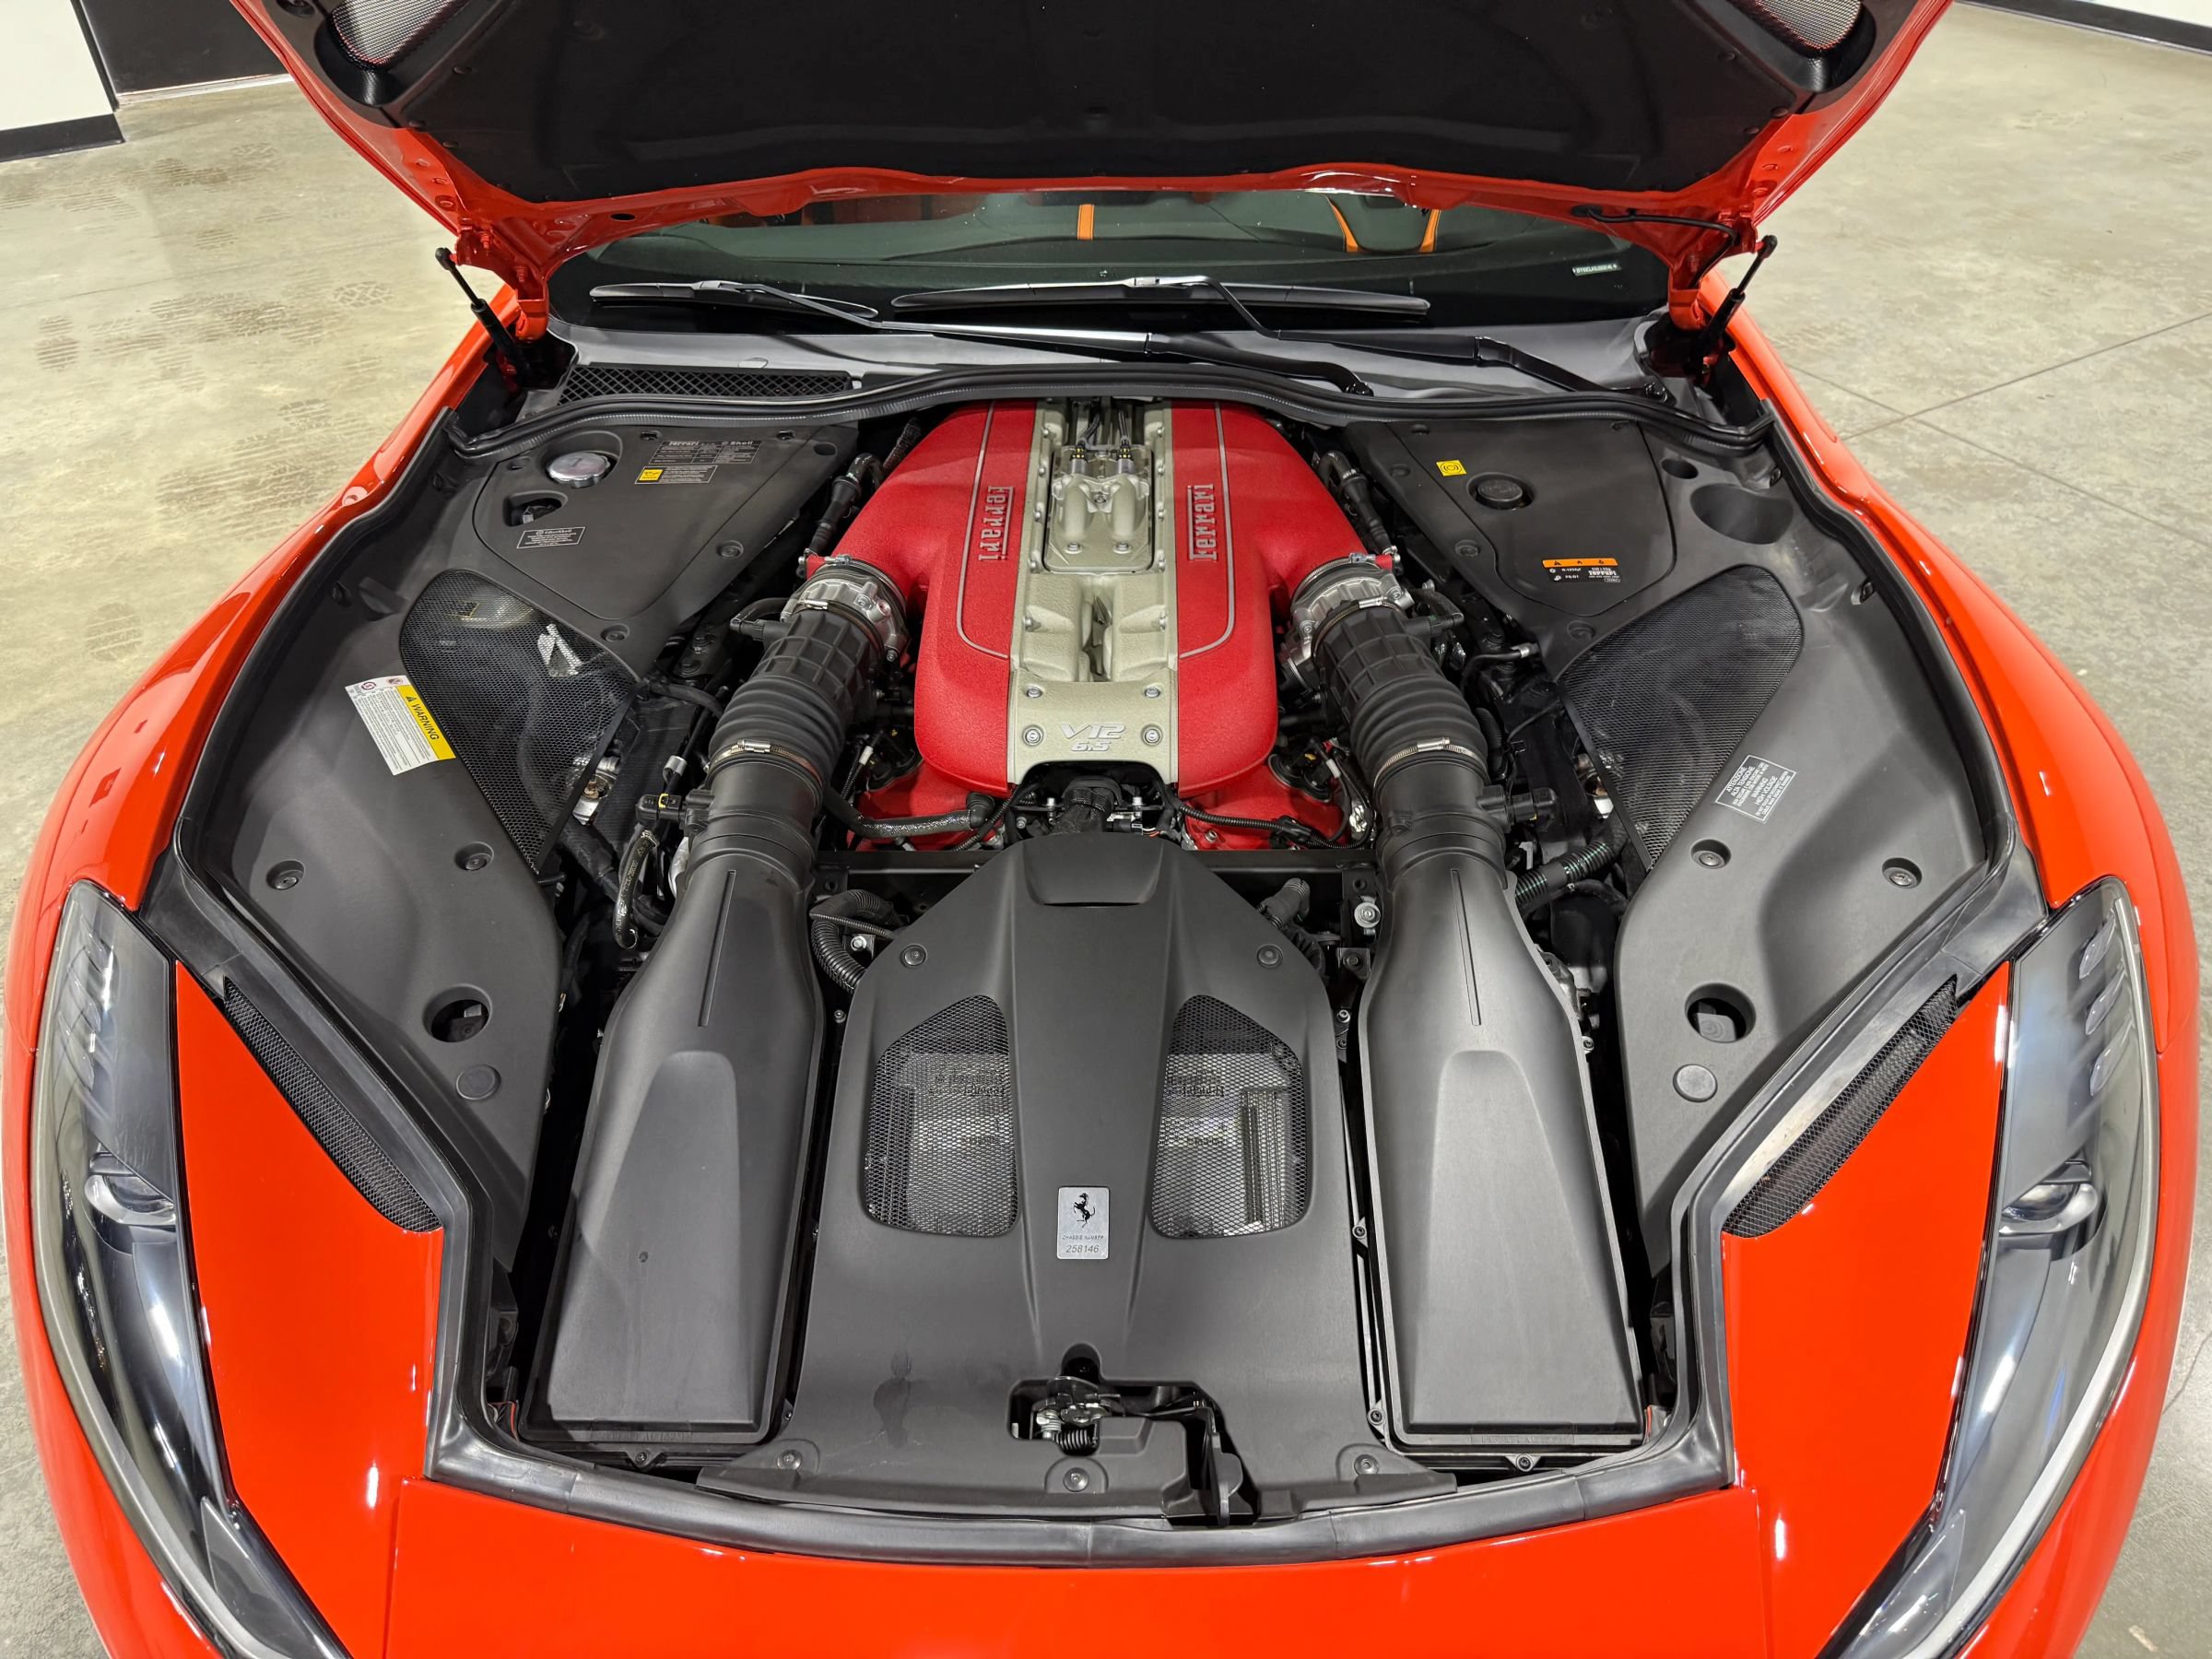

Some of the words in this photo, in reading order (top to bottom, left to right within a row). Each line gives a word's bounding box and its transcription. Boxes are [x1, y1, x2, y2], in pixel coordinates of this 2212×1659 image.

[978, 485, 1014, 561] Ferrari
[1187, 483, 1218, 561] Ferrari
[412, 703, 440, 740] WARNING
[1060, 723, 1126, 740] V12
[1071, 740, 1112, 752] 6.5
[1065, 1244, 1100, 1253] 258146
